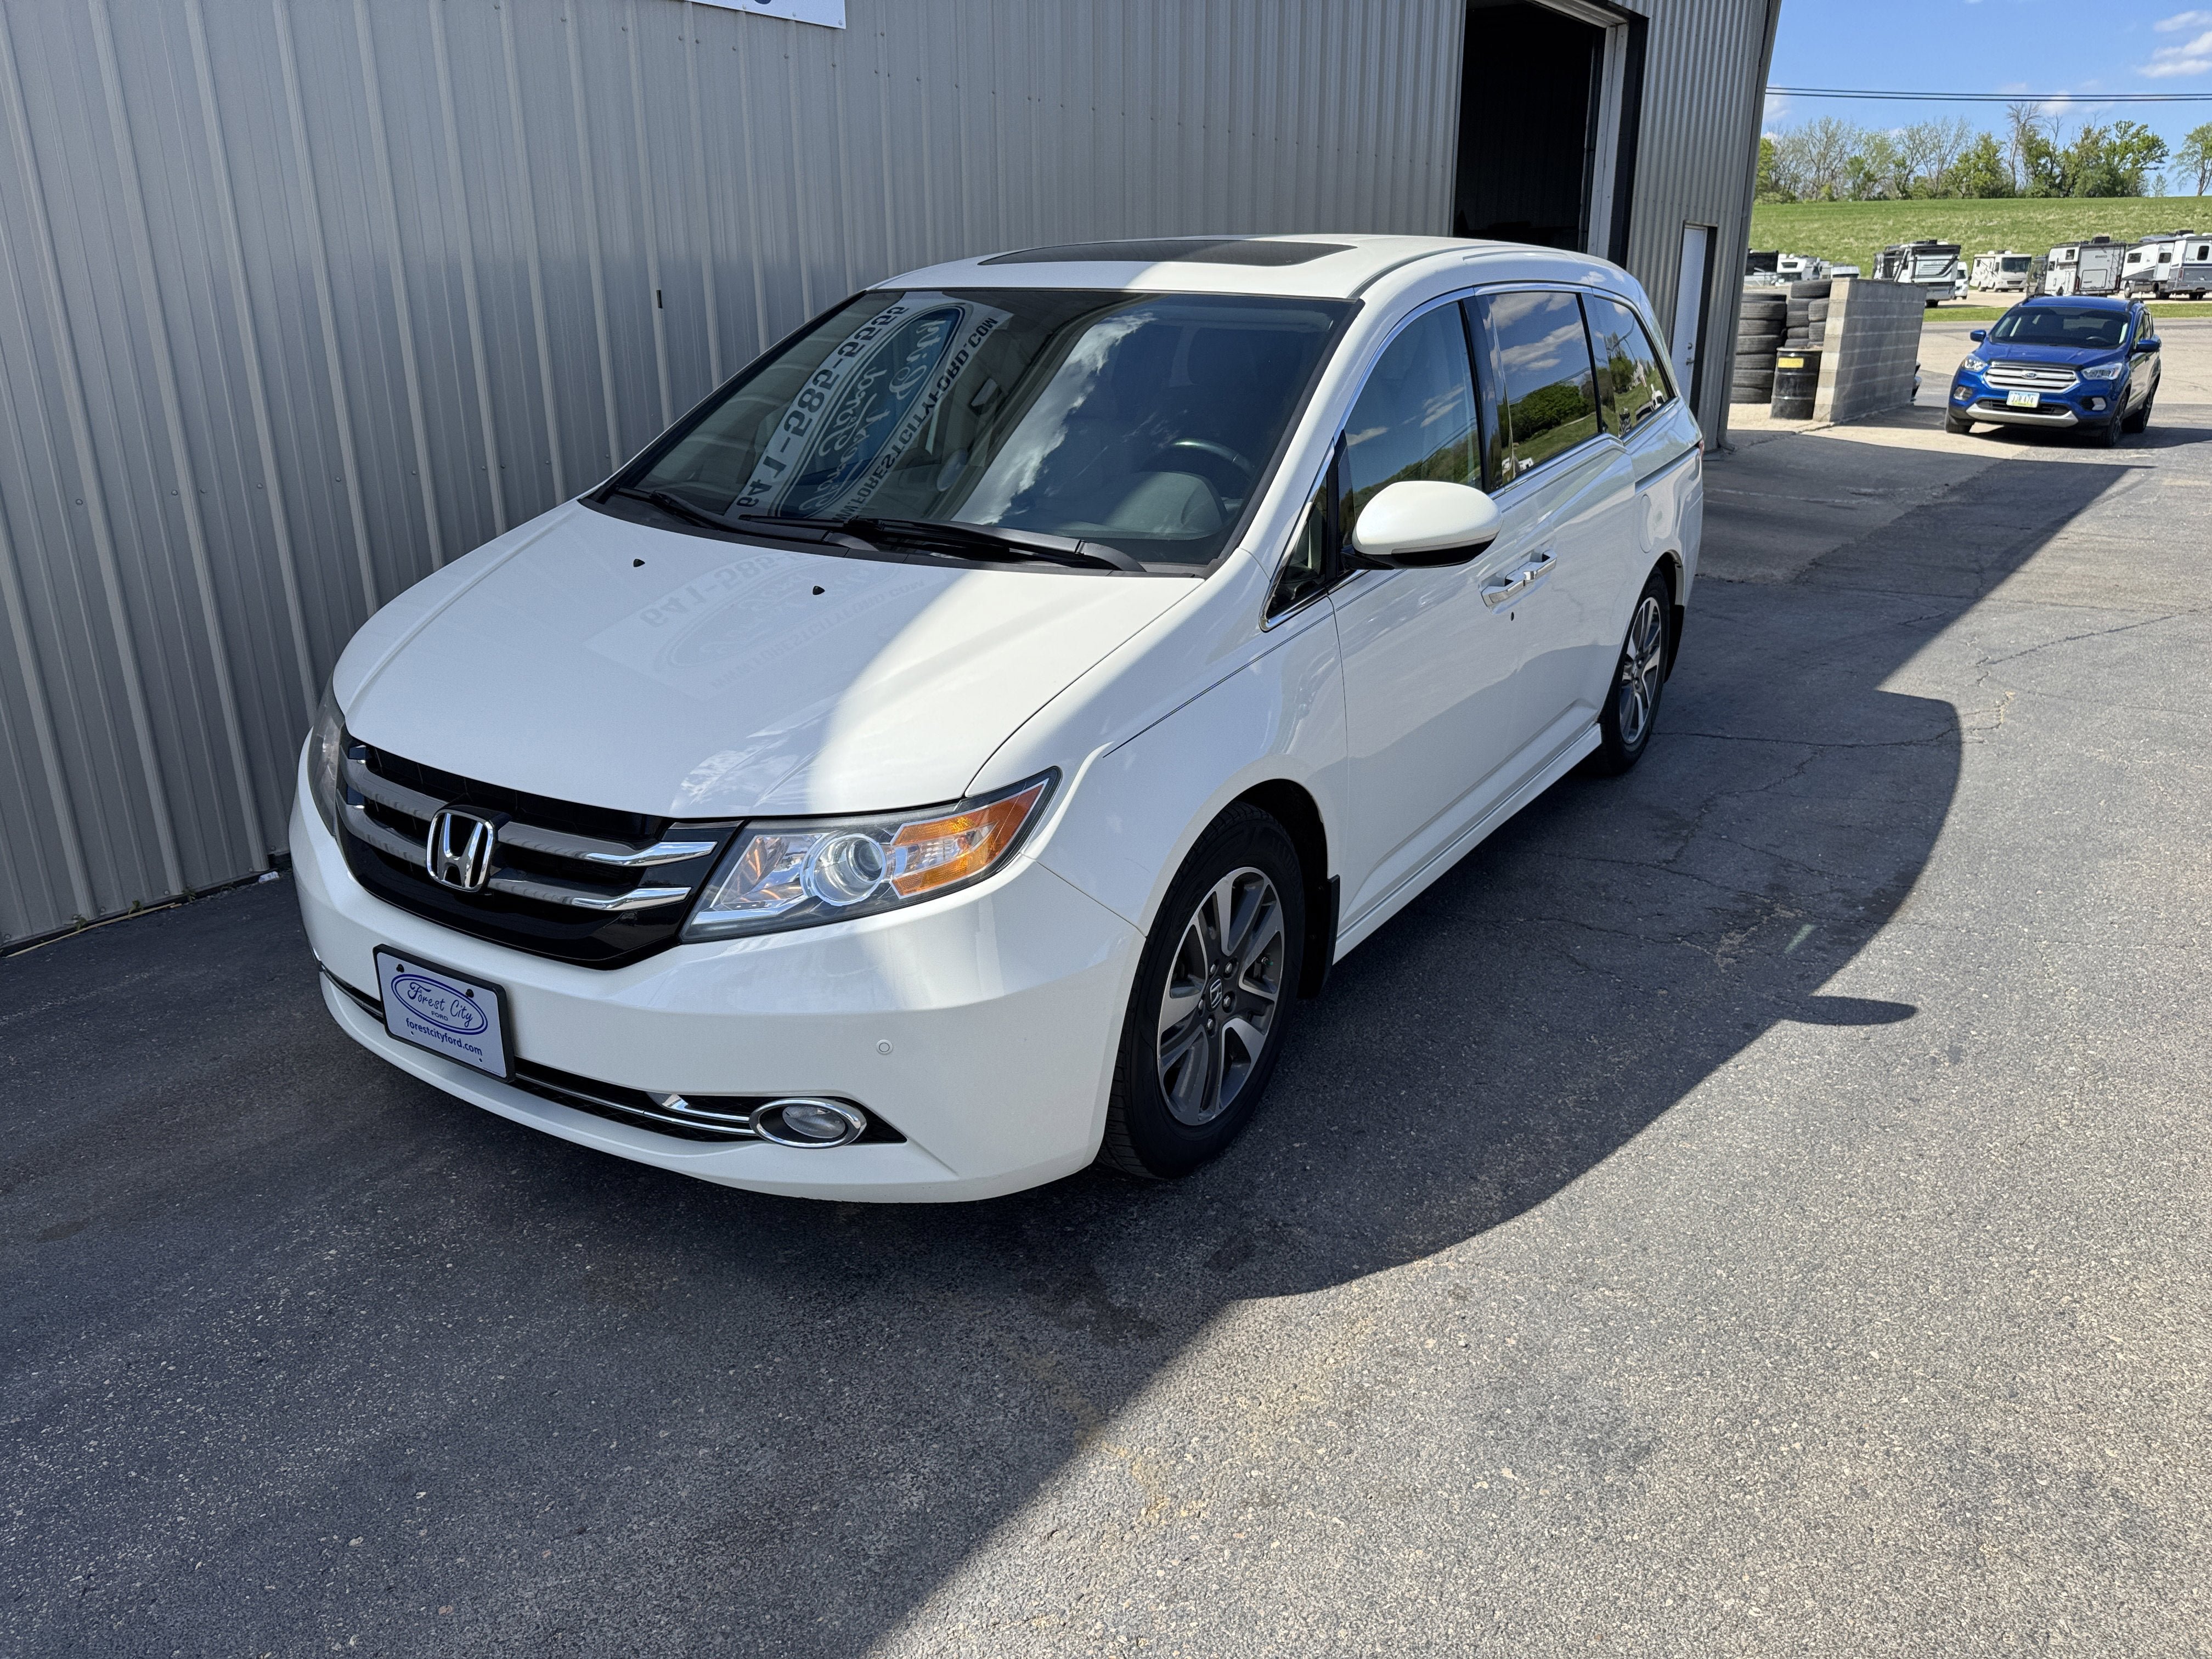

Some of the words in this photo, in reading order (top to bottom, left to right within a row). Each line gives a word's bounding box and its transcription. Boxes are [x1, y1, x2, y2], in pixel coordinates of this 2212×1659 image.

[407, 981, 444, 1011] Forest
[450, 999, 473, 1028] City
[431, 1011, 448, 1022] FORD
[405, 1017, 483, 1056] forestcityford.com
